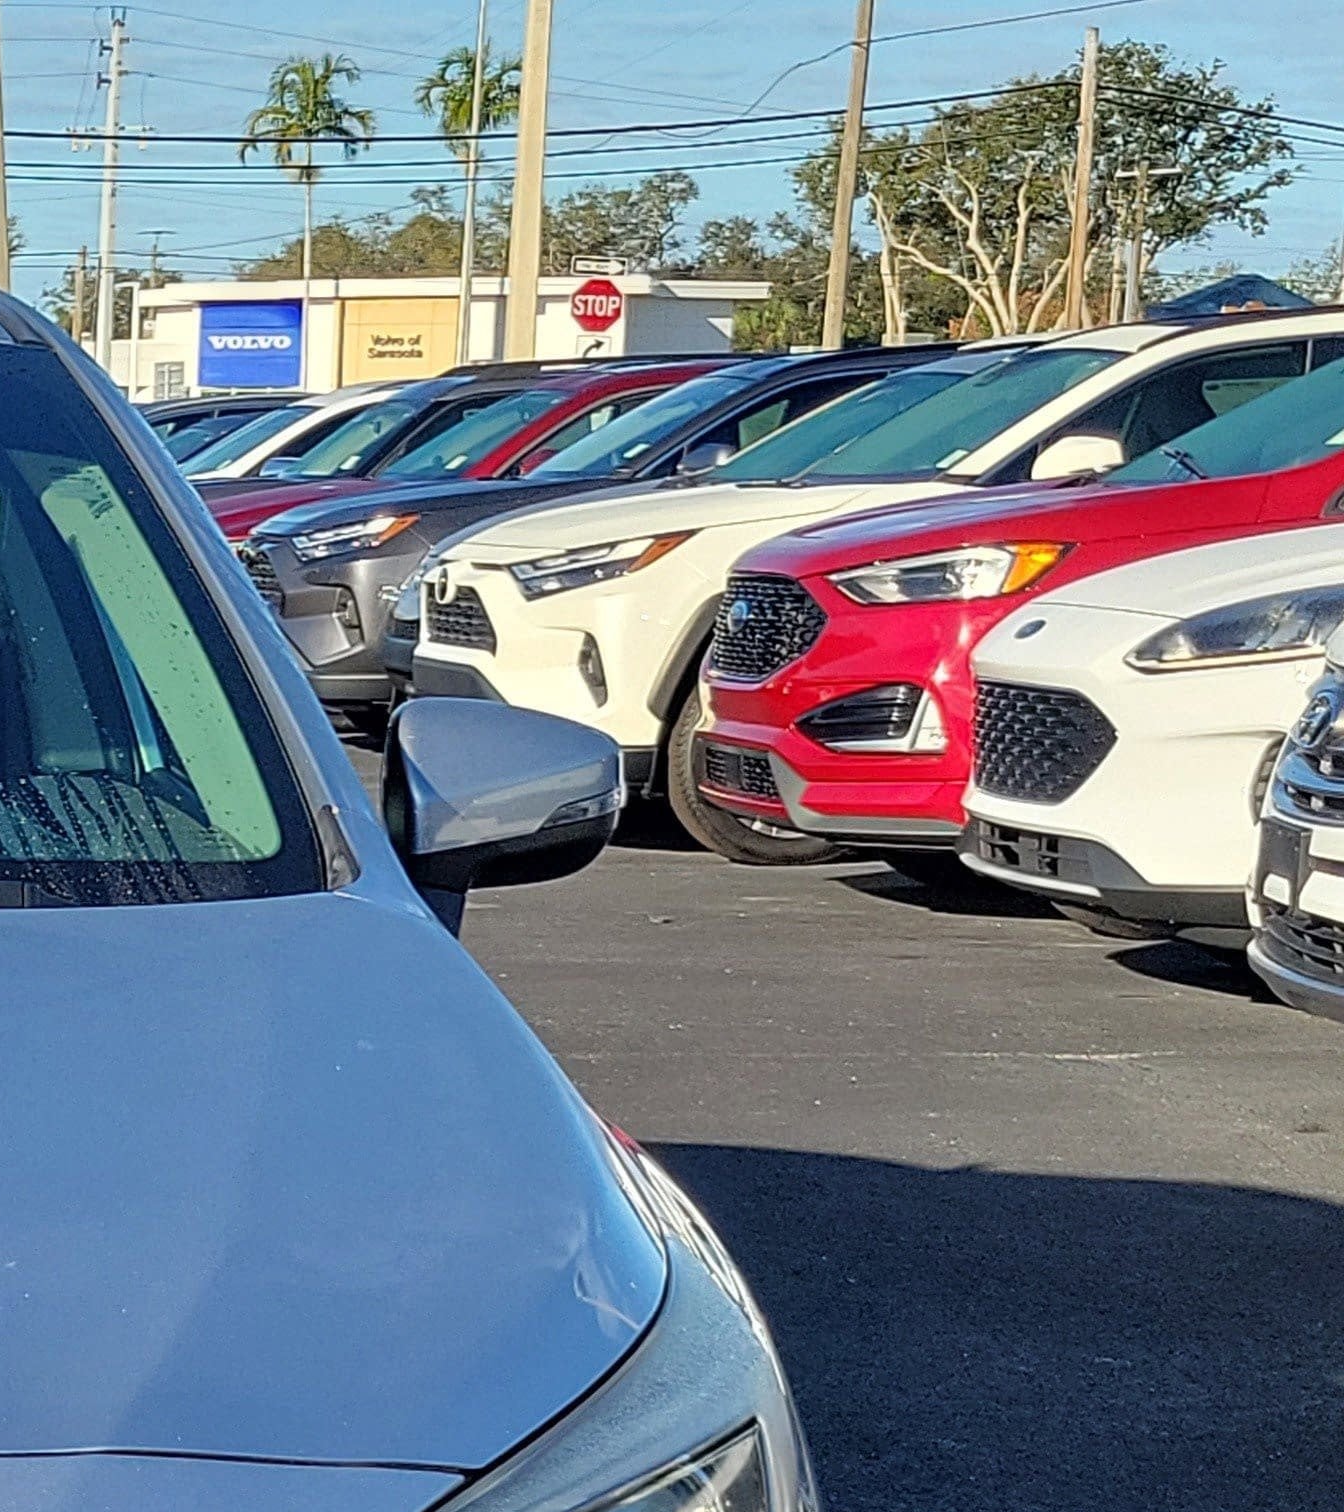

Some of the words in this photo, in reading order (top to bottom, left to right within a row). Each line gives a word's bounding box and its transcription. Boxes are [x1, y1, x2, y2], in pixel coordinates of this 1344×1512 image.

[573, 294, 620, 317] STOP
[208, 335, 292, 349] VOLVO
[370, 334, 405, 346] Volvo
